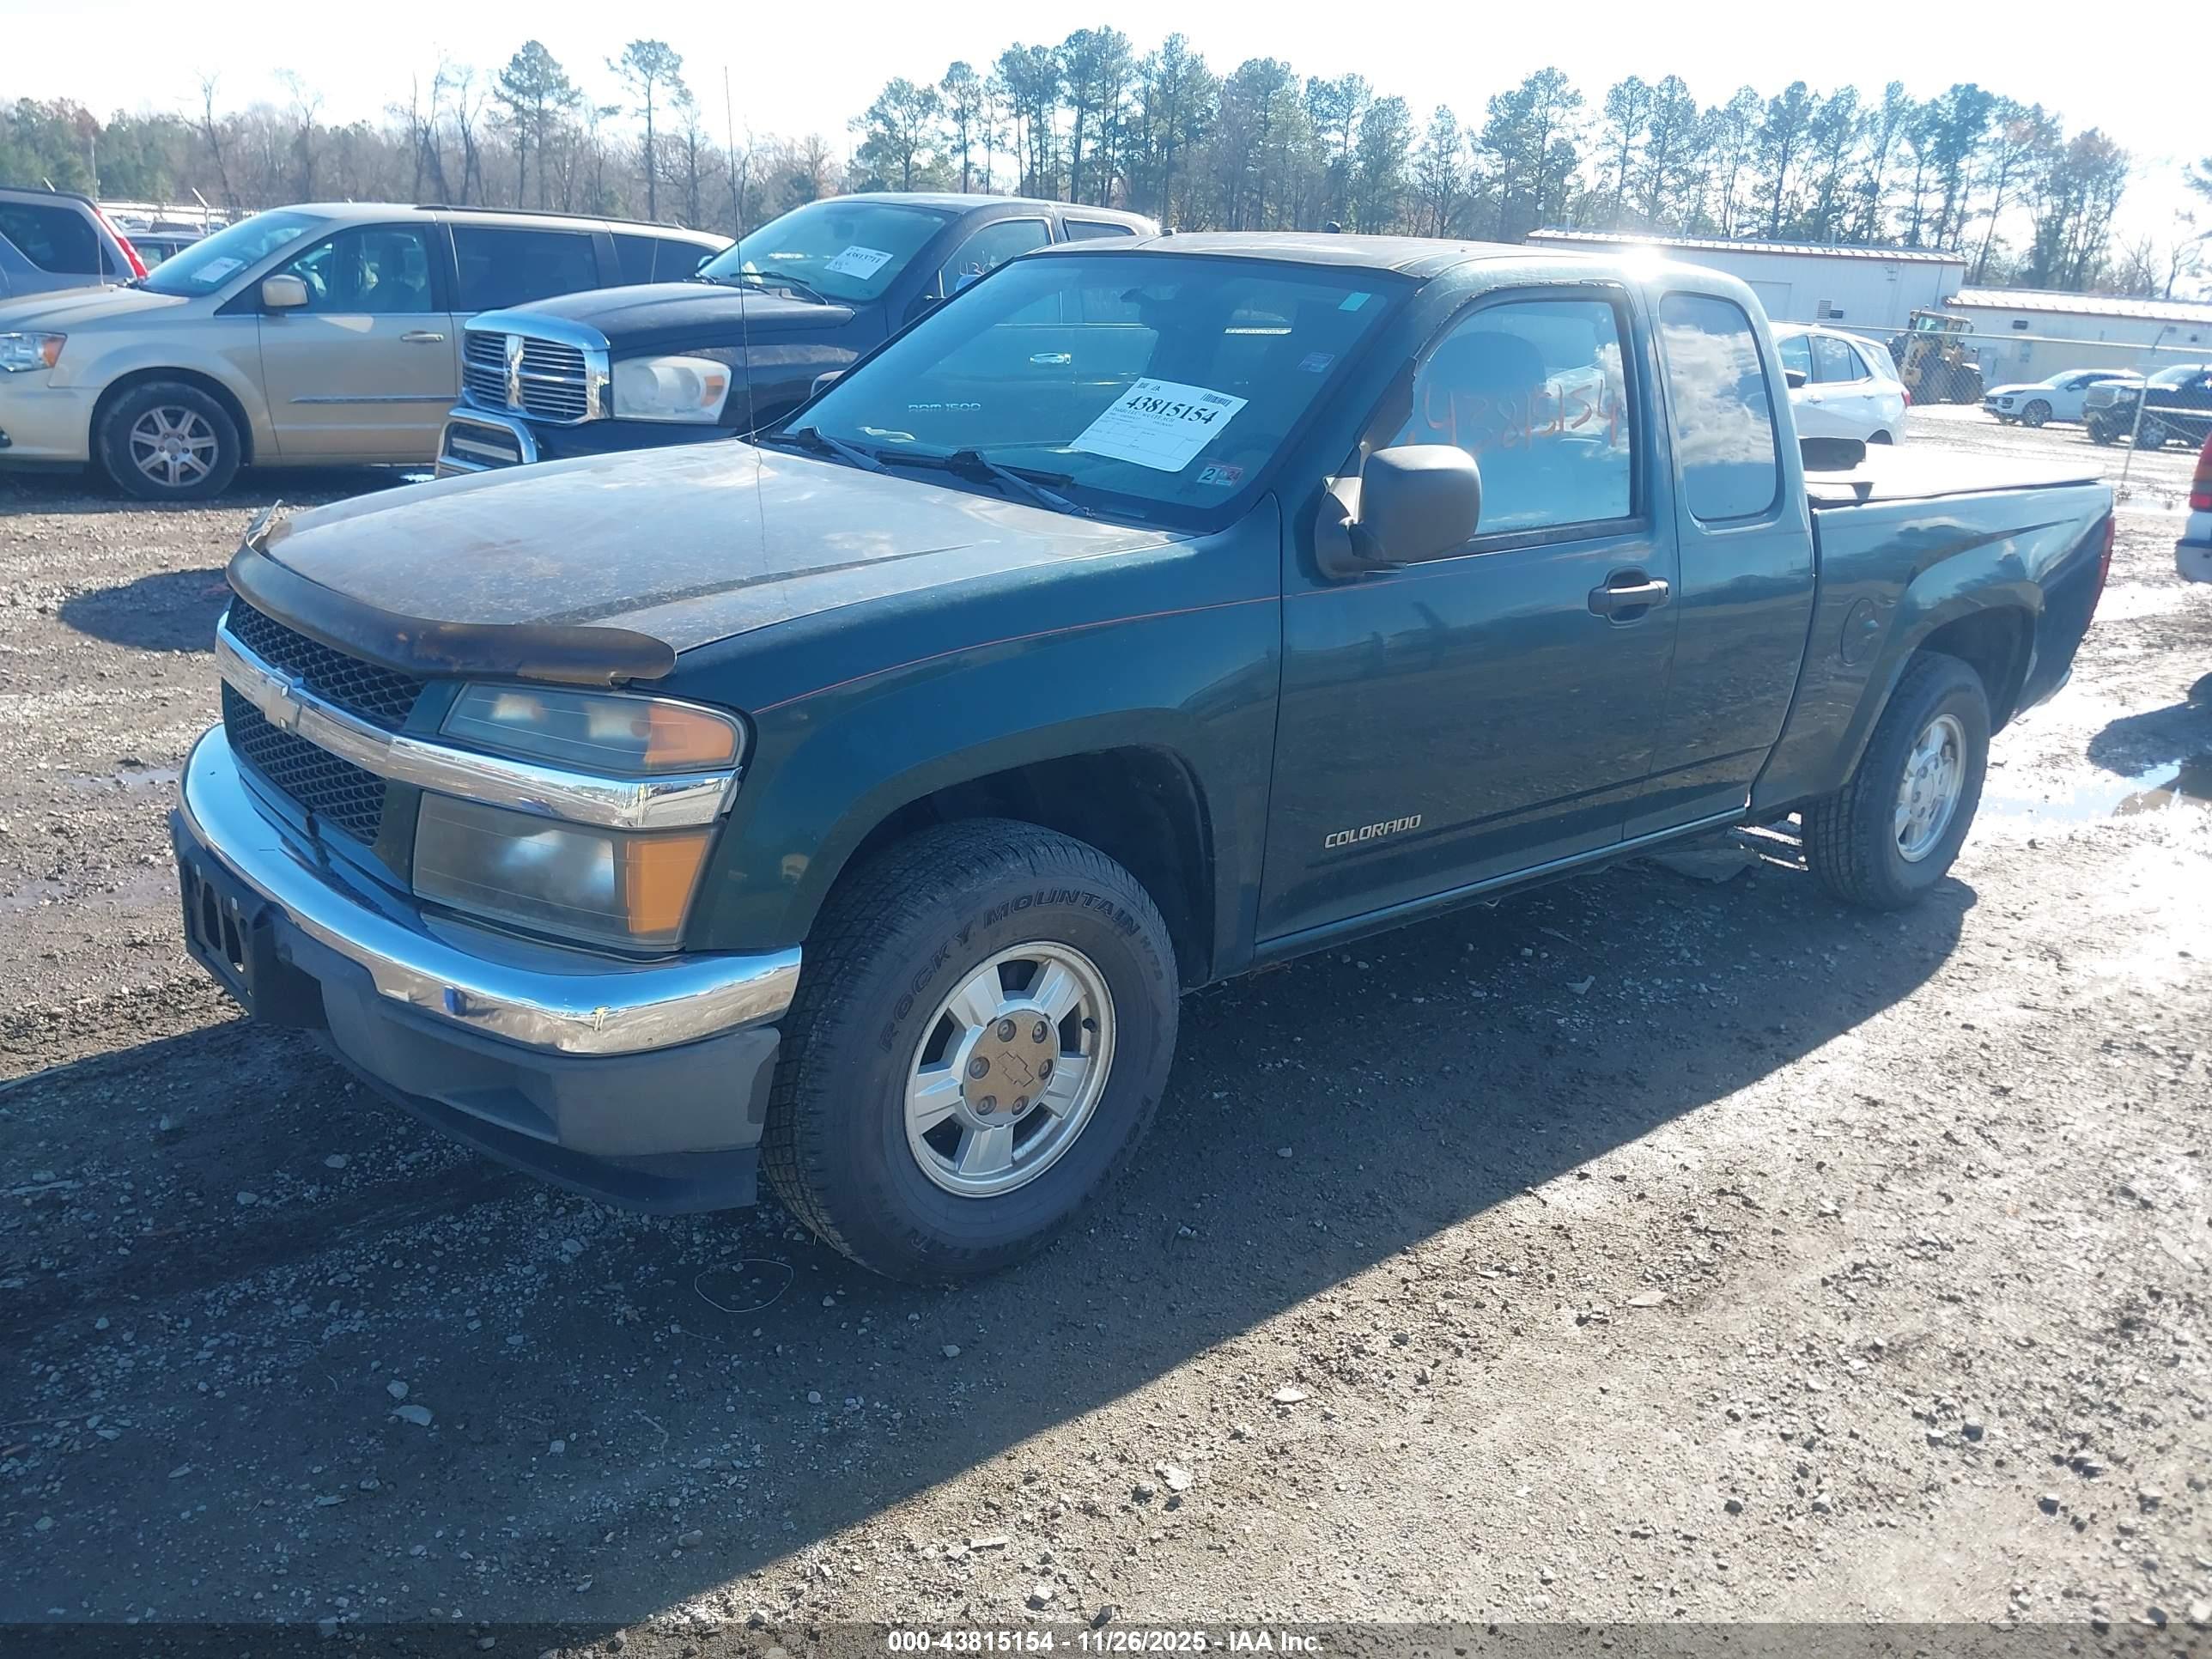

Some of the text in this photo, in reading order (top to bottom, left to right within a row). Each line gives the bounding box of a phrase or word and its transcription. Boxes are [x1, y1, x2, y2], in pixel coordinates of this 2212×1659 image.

[945, 402, 981, 412] 1500
[1126, 395, 1219, 424] 43815154
[1201, 468, 1216, 481] 2
[1324, 814, 1422, 849] COLORADO
[880, 921, 975, 1053] ROCKY
[982, 888, 1141, 938] MOUNTAIN
